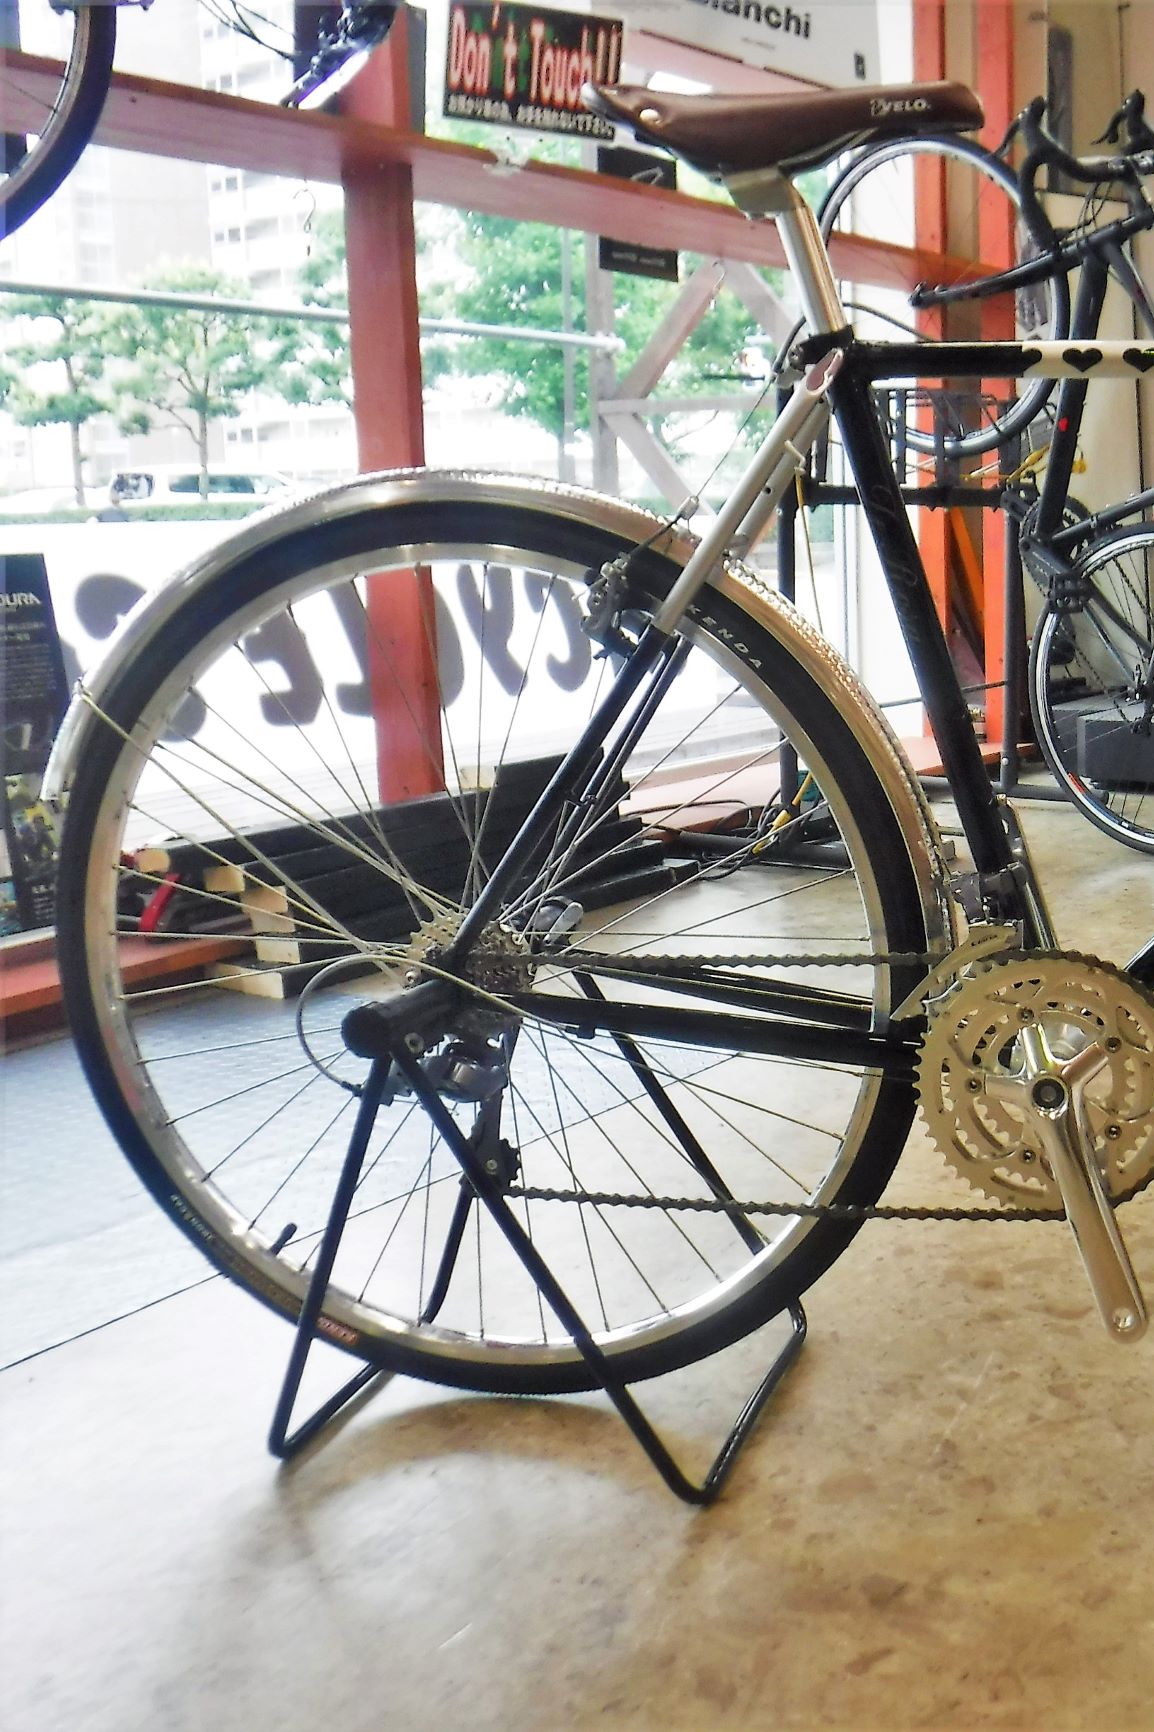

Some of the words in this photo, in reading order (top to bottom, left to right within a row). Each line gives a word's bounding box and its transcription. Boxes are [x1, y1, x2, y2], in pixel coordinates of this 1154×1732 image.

[448, 0, 519, 99] Don't
[688, 0, 811, 39] anchi
[685, 603, 765, 670] KENDA
